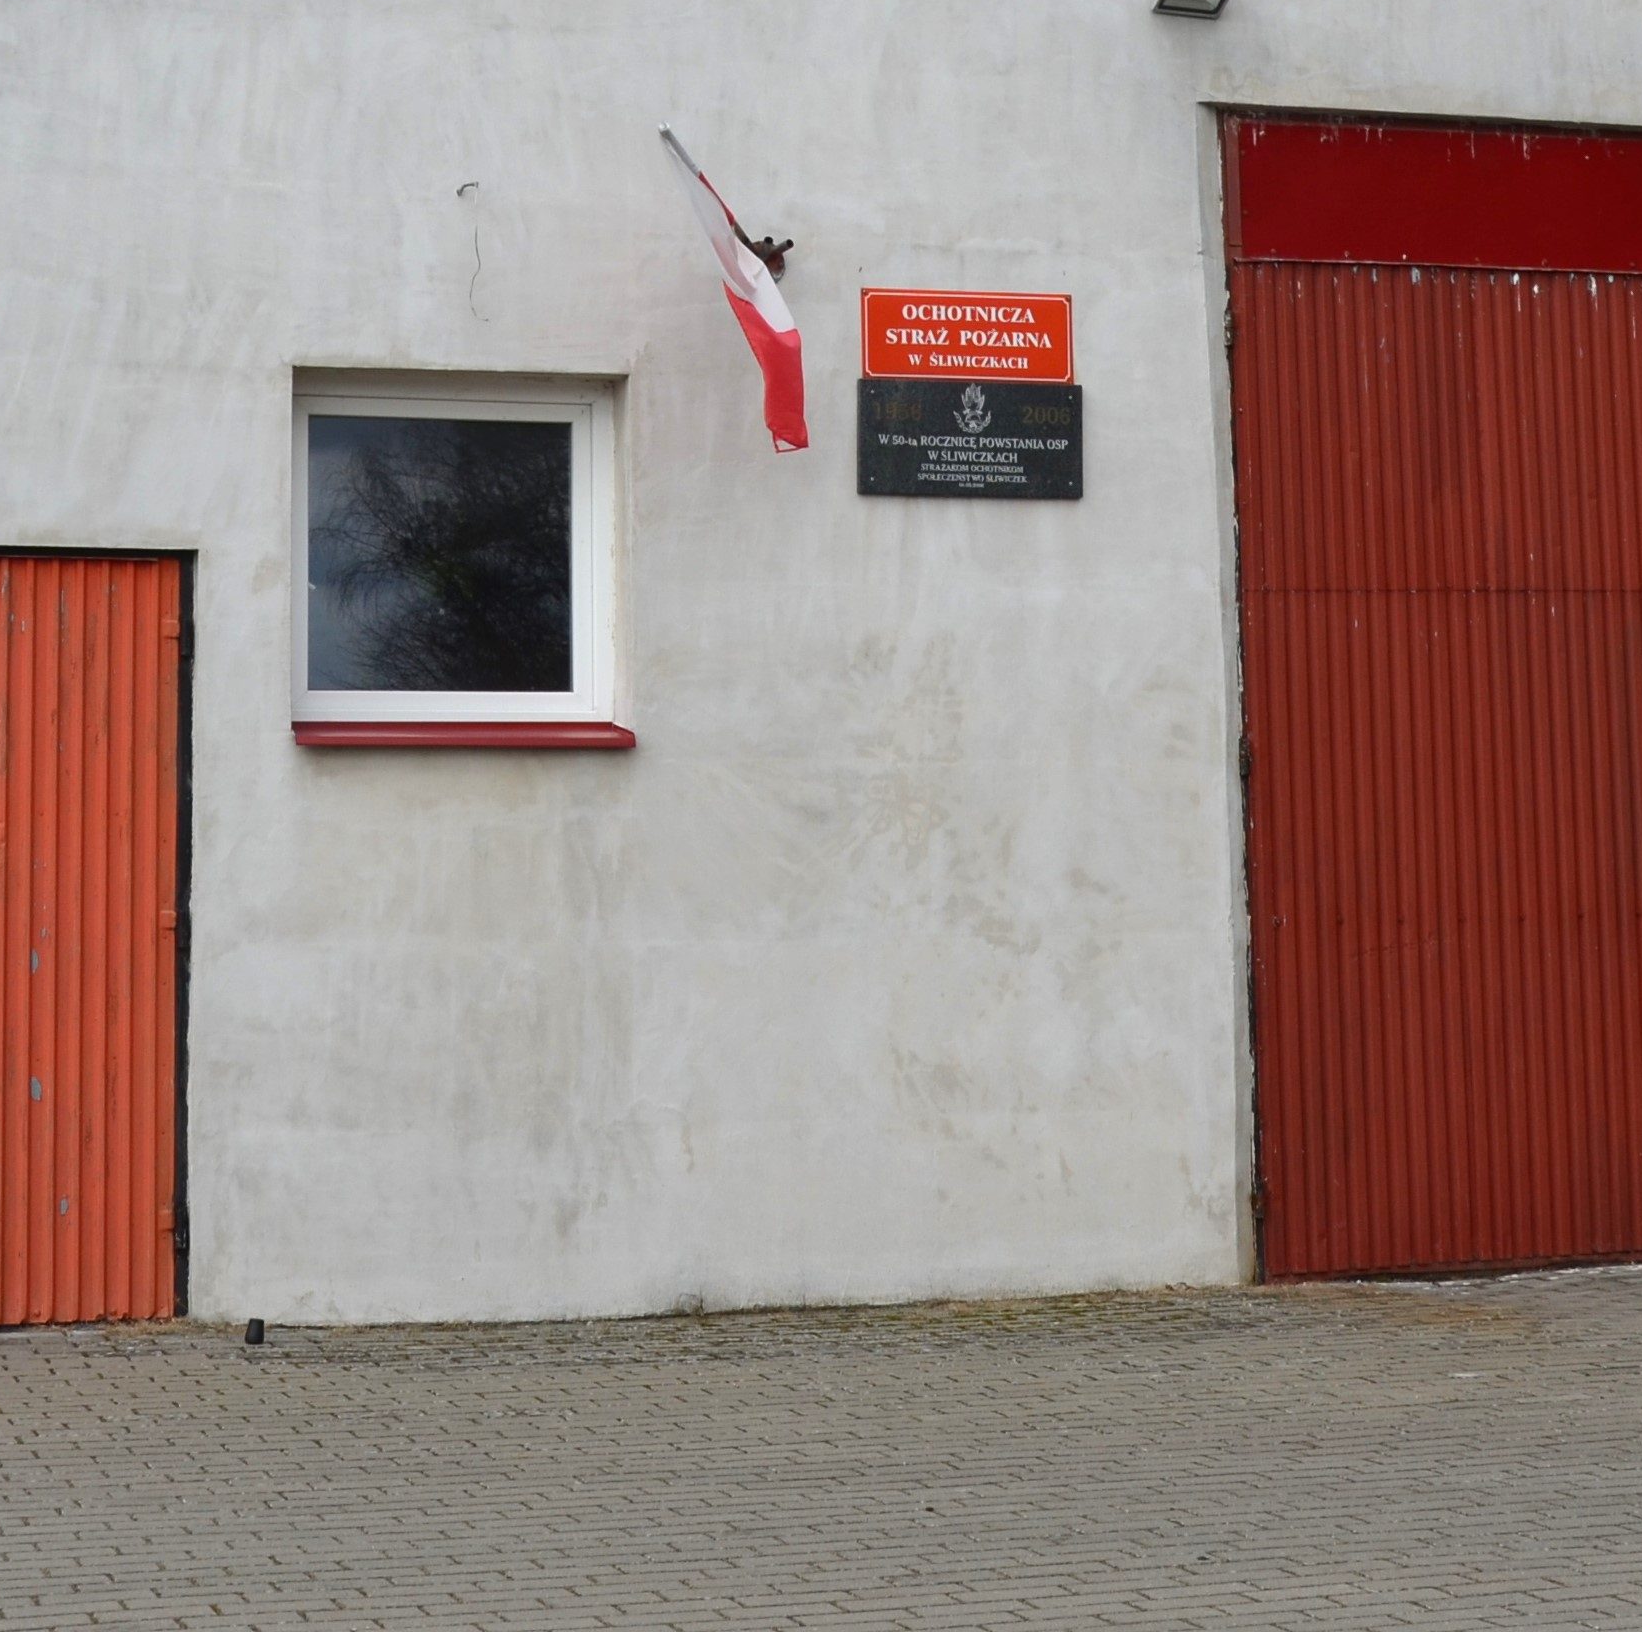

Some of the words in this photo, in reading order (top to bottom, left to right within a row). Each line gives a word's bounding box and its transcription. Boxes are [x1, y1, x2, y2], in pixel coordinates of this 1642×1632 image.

[902, 304, 1035, 324] OCHOTNICZA
[885, 327, 949, 346] STRAŻ
[960, 329, 1052, 349] POŻARNA
[908, 354, 922, 366] W
[930, 352, 1029, 369] ŚLIWICZKACH
[1022, 406, 1071, 425] 2006
[878, 434, 890, 445] W
[920, 435, 977, 449] ROCZNICĘ
[979, 437, 1044, 449] POWSTANIA
[1046, 439, 1068, 450] OSP
[927, 450, 939, 461] W
[941, 449, 1018, 463] ŚLIWICZKACH
